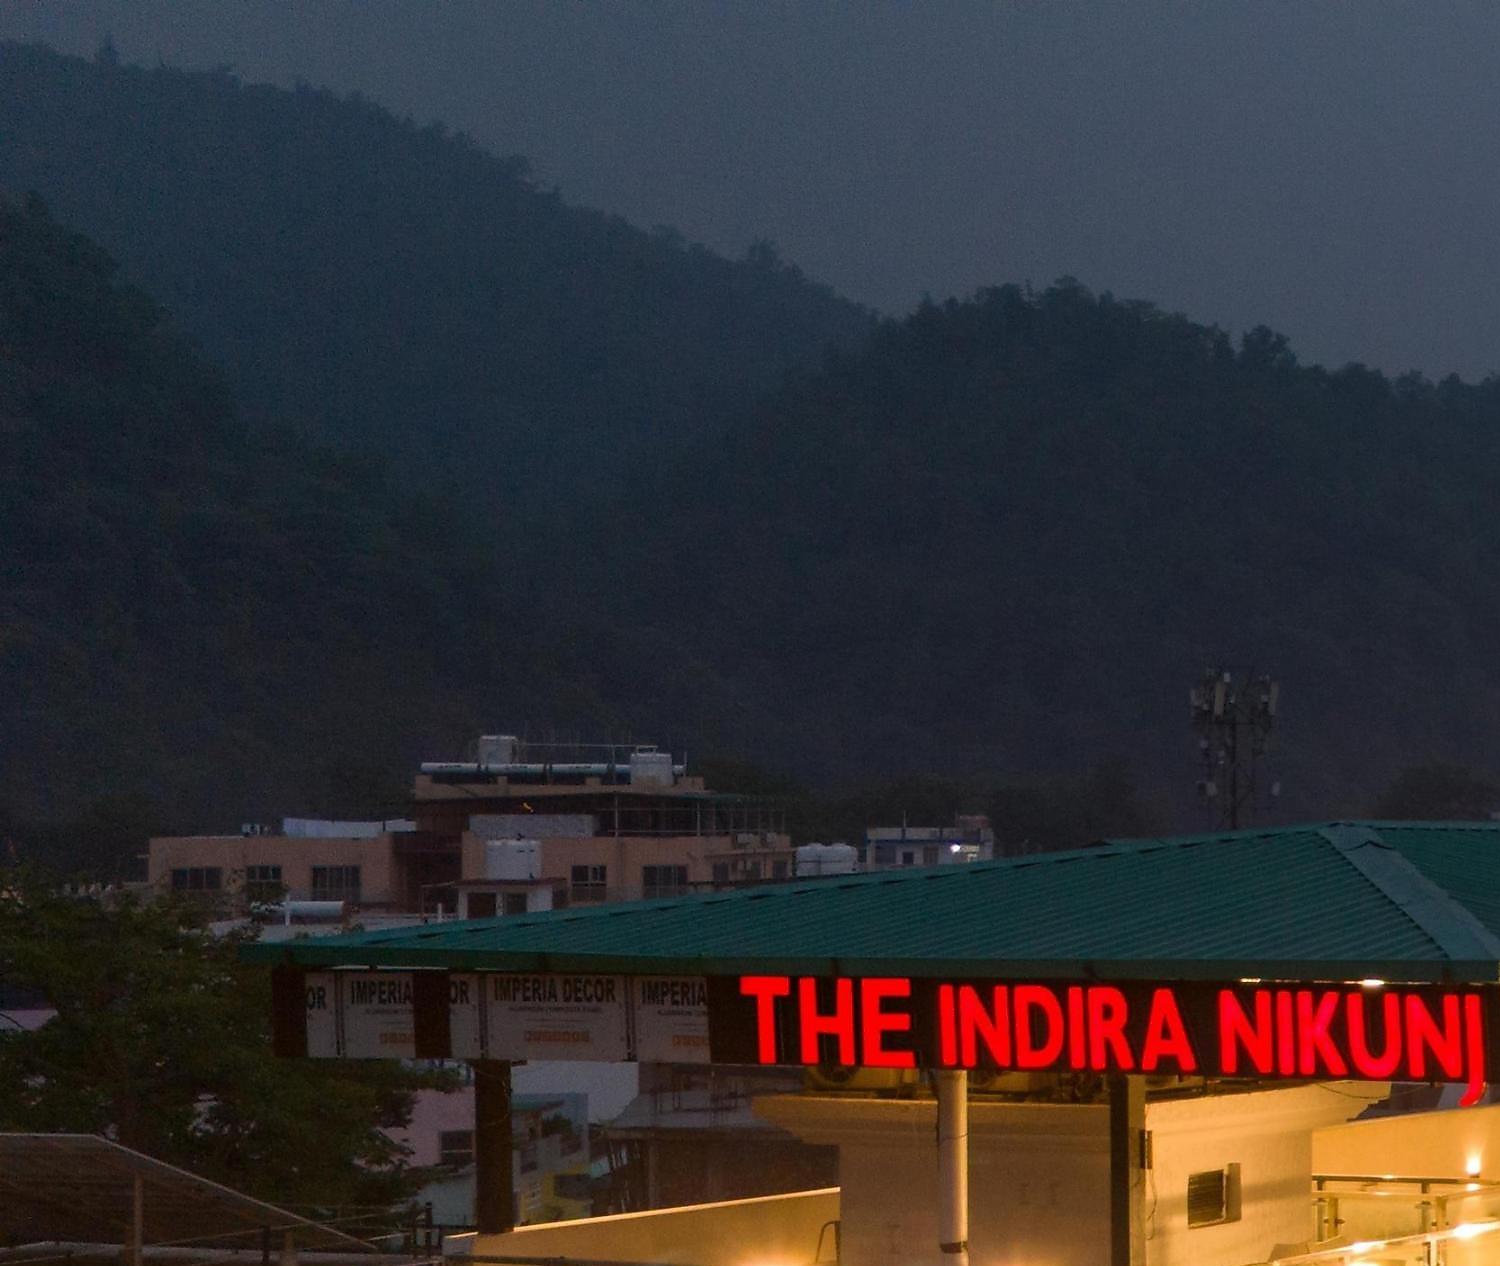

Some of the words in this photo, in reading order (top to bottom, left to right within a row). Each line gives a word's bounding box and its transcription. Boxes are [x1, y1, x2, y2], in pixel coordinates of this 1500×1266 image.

[351, 979, 416, 1005] IMPERIA
[494, 976, 557, 1002] IMPERIA
[563, 976, 617, 1002] DECOR
[641, 980, 708, 1006] IMPERIA
[739, 976, 915, 1068] THE
[939, 984, 1196, 1071] INDIRA
[1218, 989, 1487, 1108] NIKUNJ
